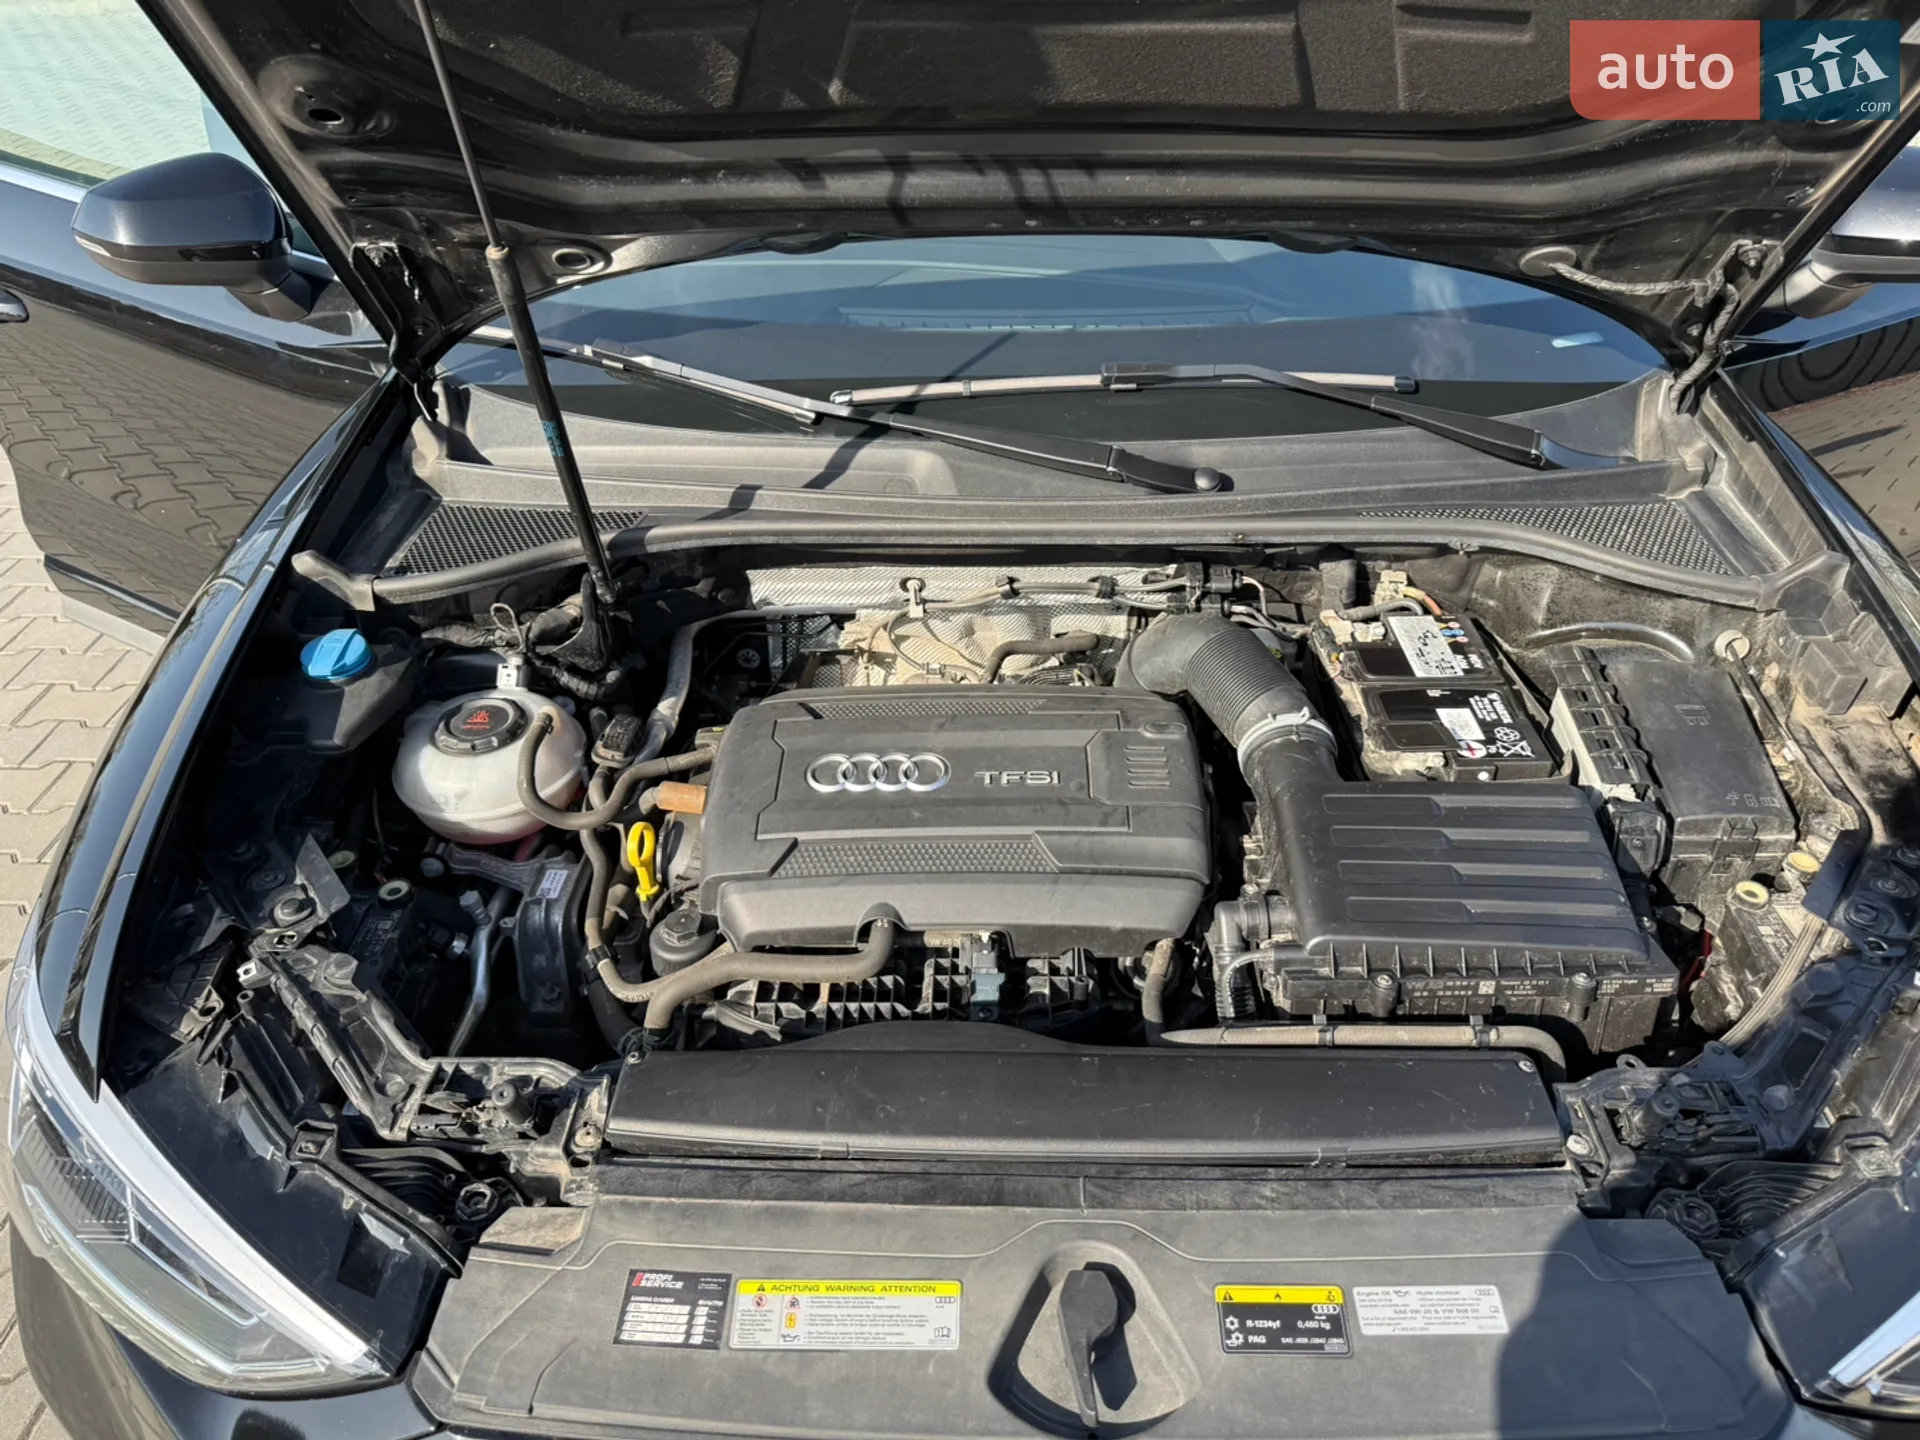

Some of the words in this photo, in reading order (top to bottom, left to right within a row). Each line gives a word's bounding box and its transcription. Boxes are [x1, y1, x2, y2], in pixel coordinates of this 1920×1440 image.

[975, 770, 1062, 787] TFSI
[643, 1273, 673, 1281] PROFI
[639, 1280, 684, 1289] SERVICE
[771, 1284, 820, 1292] ACHTUNG
[880, 1285, 936, 1293] ATTENTION
[1246, 1319, 1280, 1329] R-1234yf
[1320, 1320, 1331, 1331] kg
[1248, 1335, 1266, 1343] PAG
